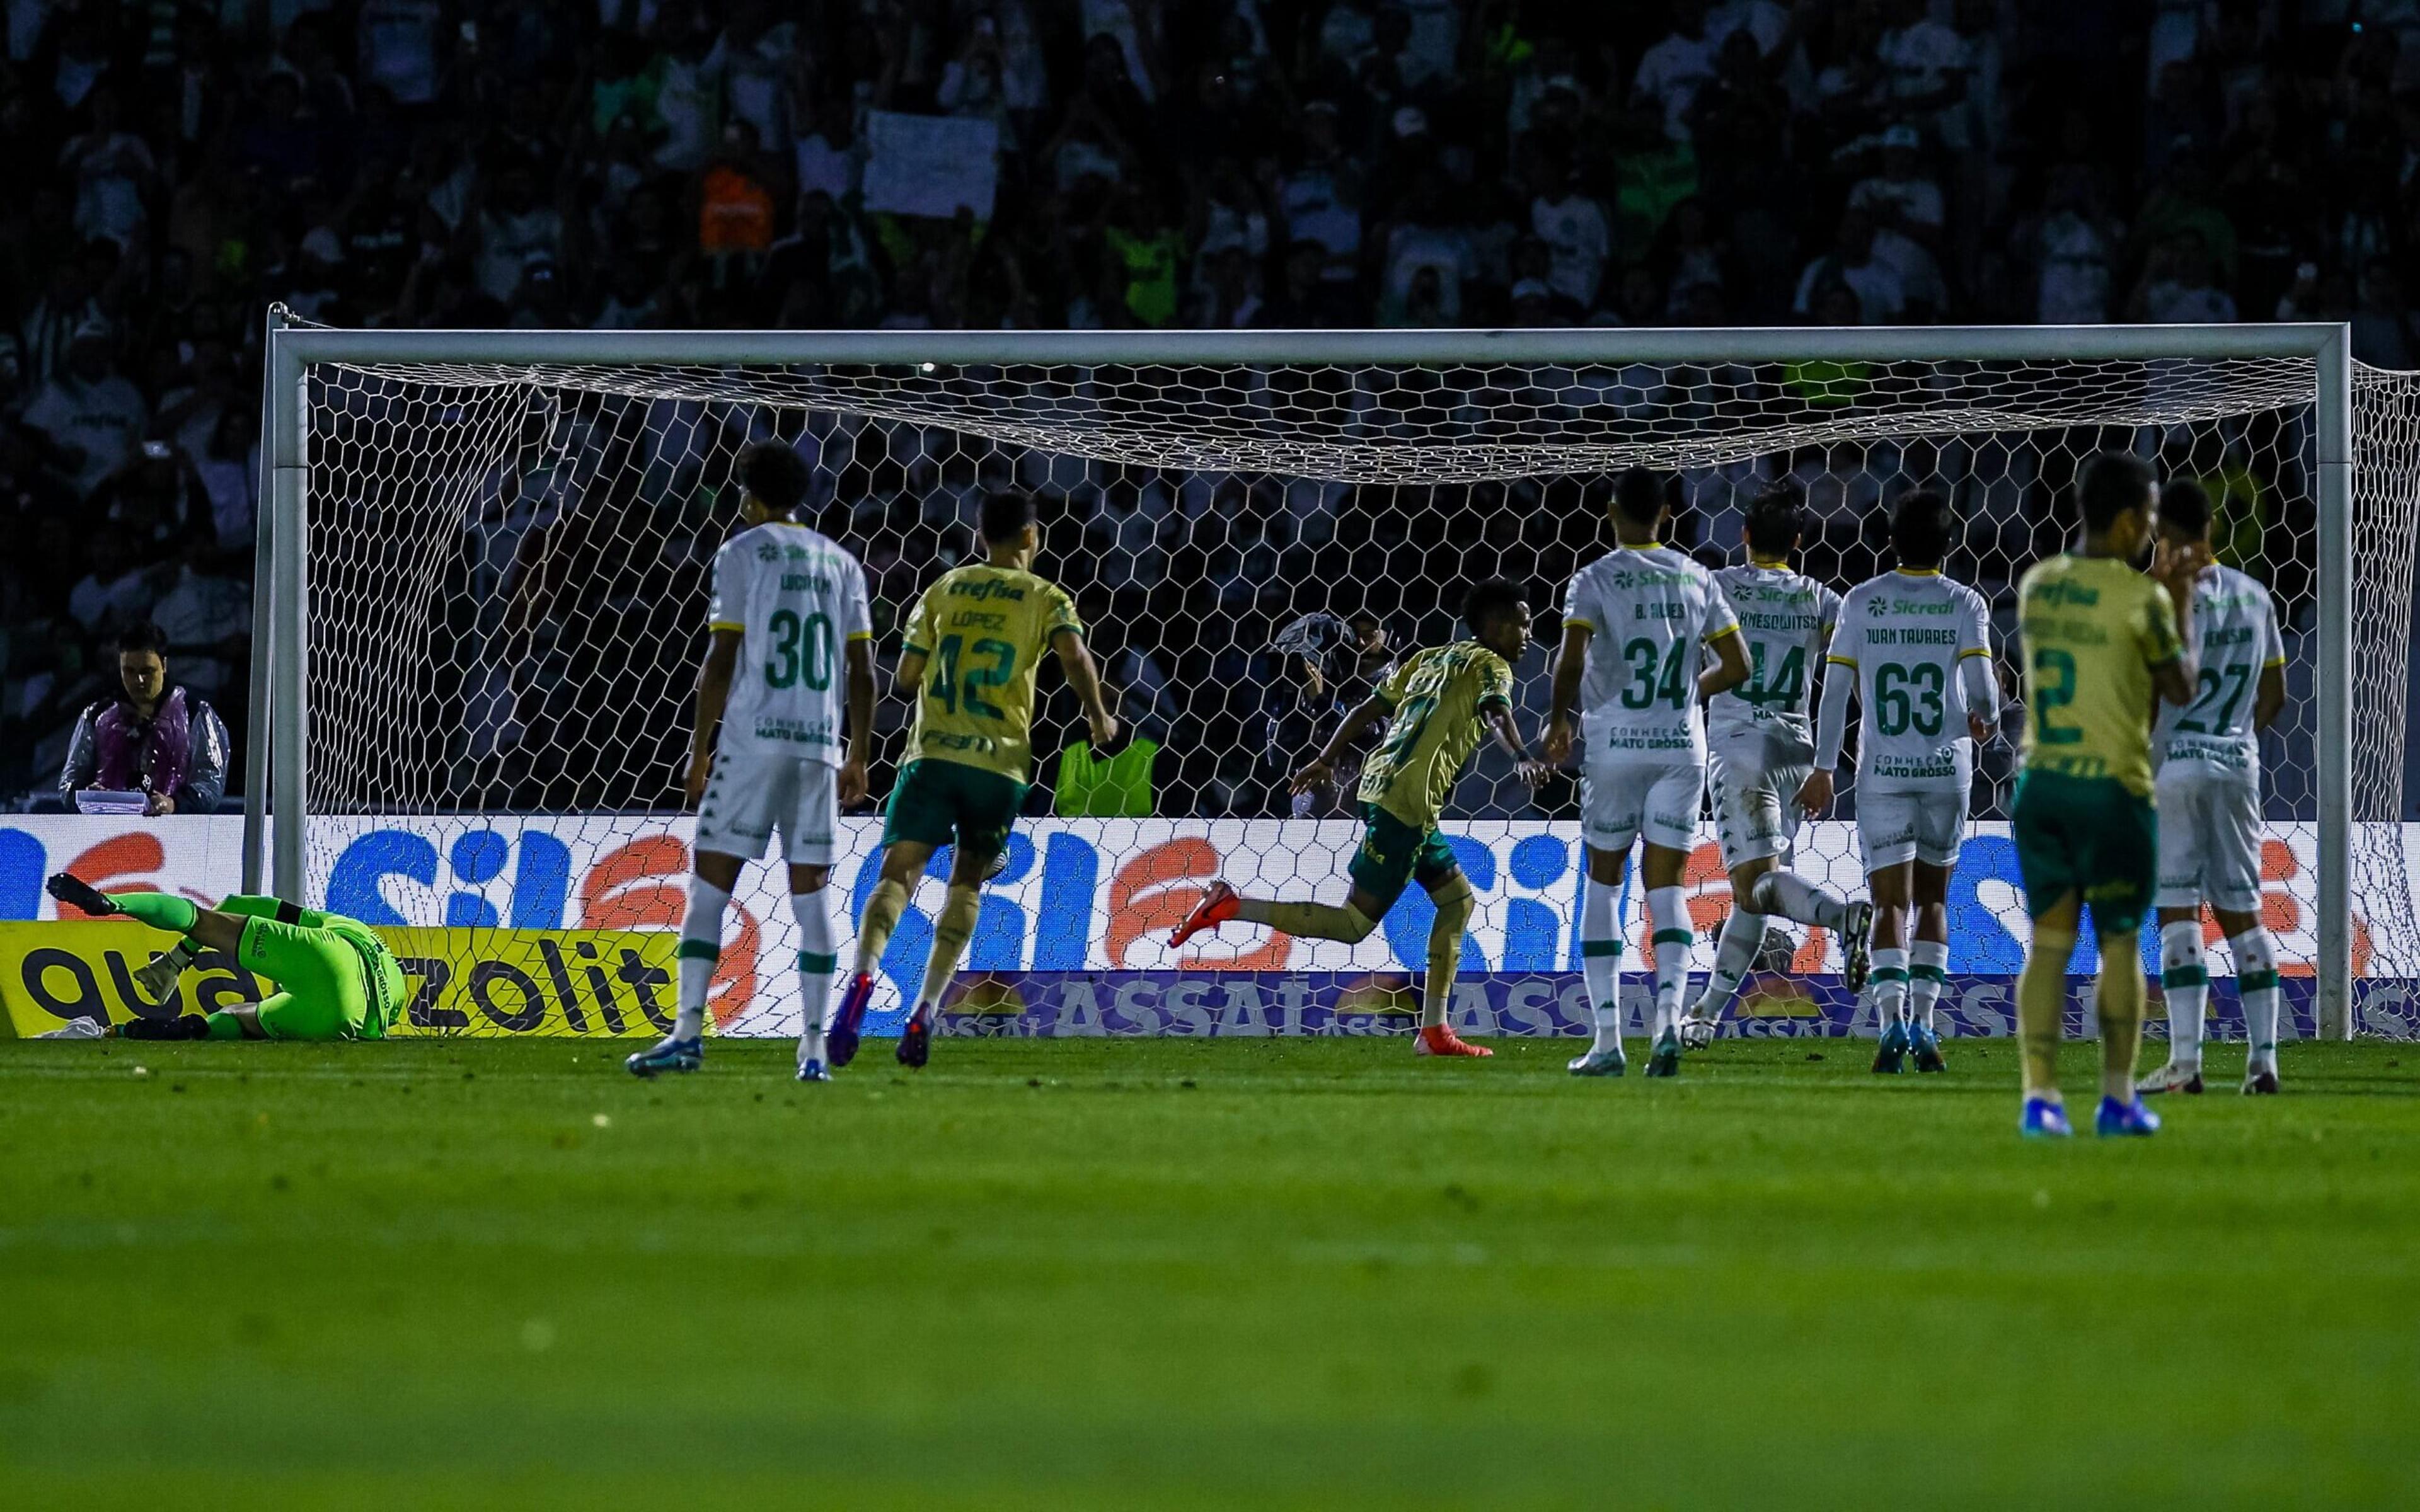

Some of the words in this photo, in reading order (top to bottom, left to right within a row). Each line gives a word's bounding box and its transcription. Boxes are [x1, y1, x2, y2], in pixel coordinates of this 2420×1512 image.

[1892, 600, 1954, 615] Sicredi
[1867, 629, 1896, 644] JUAN
[1901, 629, 1956, 644] TAVARES
[766, 609, 832, 691] 30
[930, 634, 1017, 721] 42
[1622, 636, 1687, 709] 34
[1731, 641, 1805, 713] 44
[1876, 662, 1945, 736] 63
[2035, 648, 2083, 744] 2
[2174, 663, 2251, 736] 27
[1753, 711, 1775, 721] MA
[1610, 726, 1680, 738] CONHEÇA
[1610, 738, 1643, 749] MATO
[1647, 738, 1693, 750] GROSSO
[1876, 754, 1942, 765] CONHEÇA
[1874, 765, 1908, 777] MATO
[1911, 765, 1956, 777] GROSSO
[1324, 1017, 1415, 1036] ASSA
